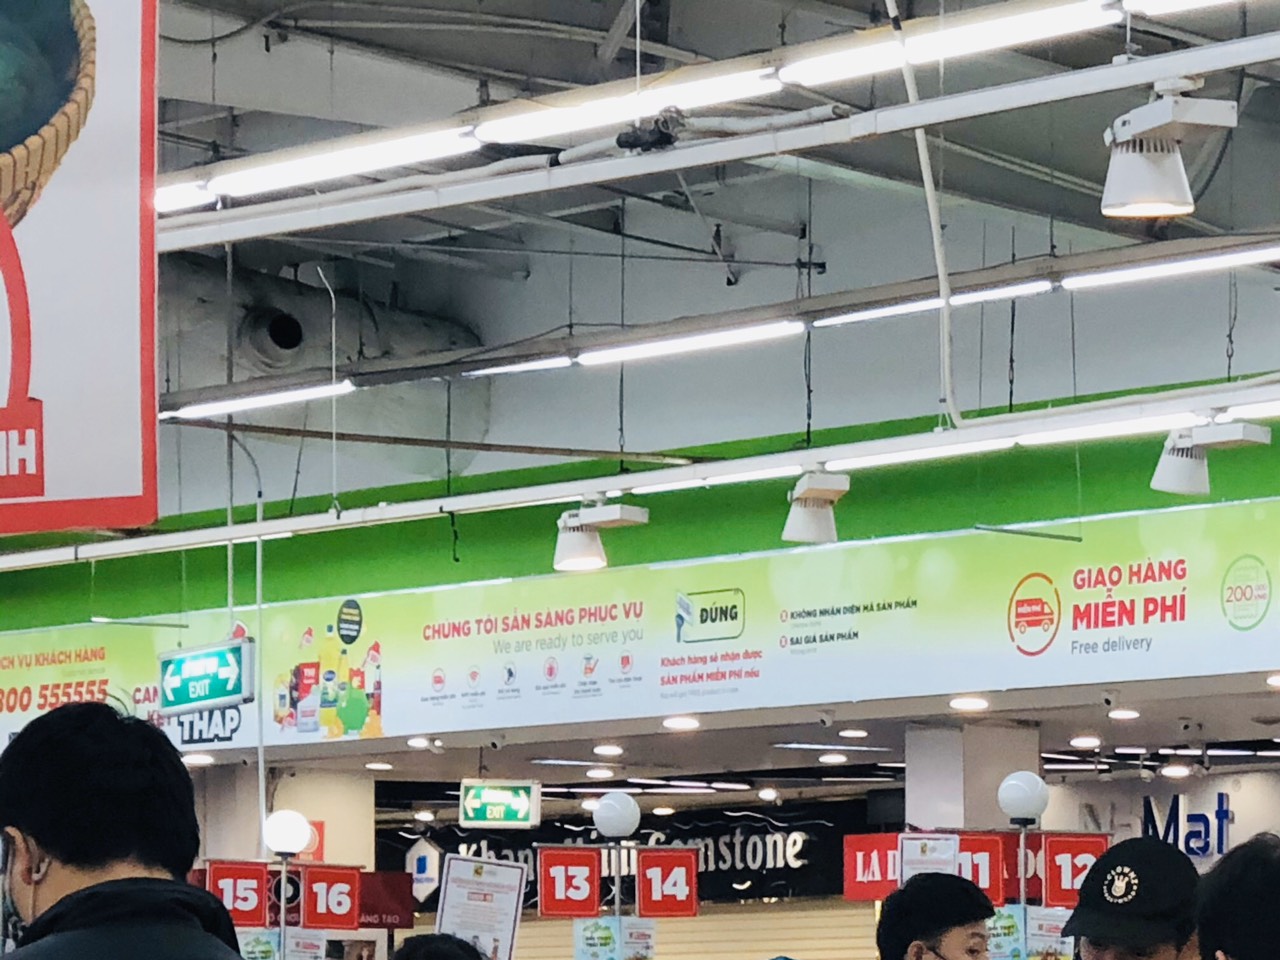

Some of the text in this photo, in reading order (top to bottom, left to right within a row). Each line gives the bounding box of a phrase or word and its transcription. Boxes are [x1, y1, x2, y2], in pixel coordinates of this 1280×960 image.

[1073, 557, 1187, 590] GIAO HÀNG
[1072, 587, 1187, 631] MIỄN PHÍ
[1226, 585, 1253, 603] 200
[700, 601, 738, 624] ĐÚNG
[492, 628, 644, 654] We are ready to serve you
[1071, 635, 1152, 655] Free delivery
[37, 679, 109, 711] 555555
[188, 679, 211, 698] EXIT
[486, 806, 505, 819] EXIT
[550, 866, 590, 900] 13
[646, 866, 689, 901] 14
[1055, 853, 1097, 890] 12
[218, 878, 258, 911] 15
[312, 882, 352, 915] 16
